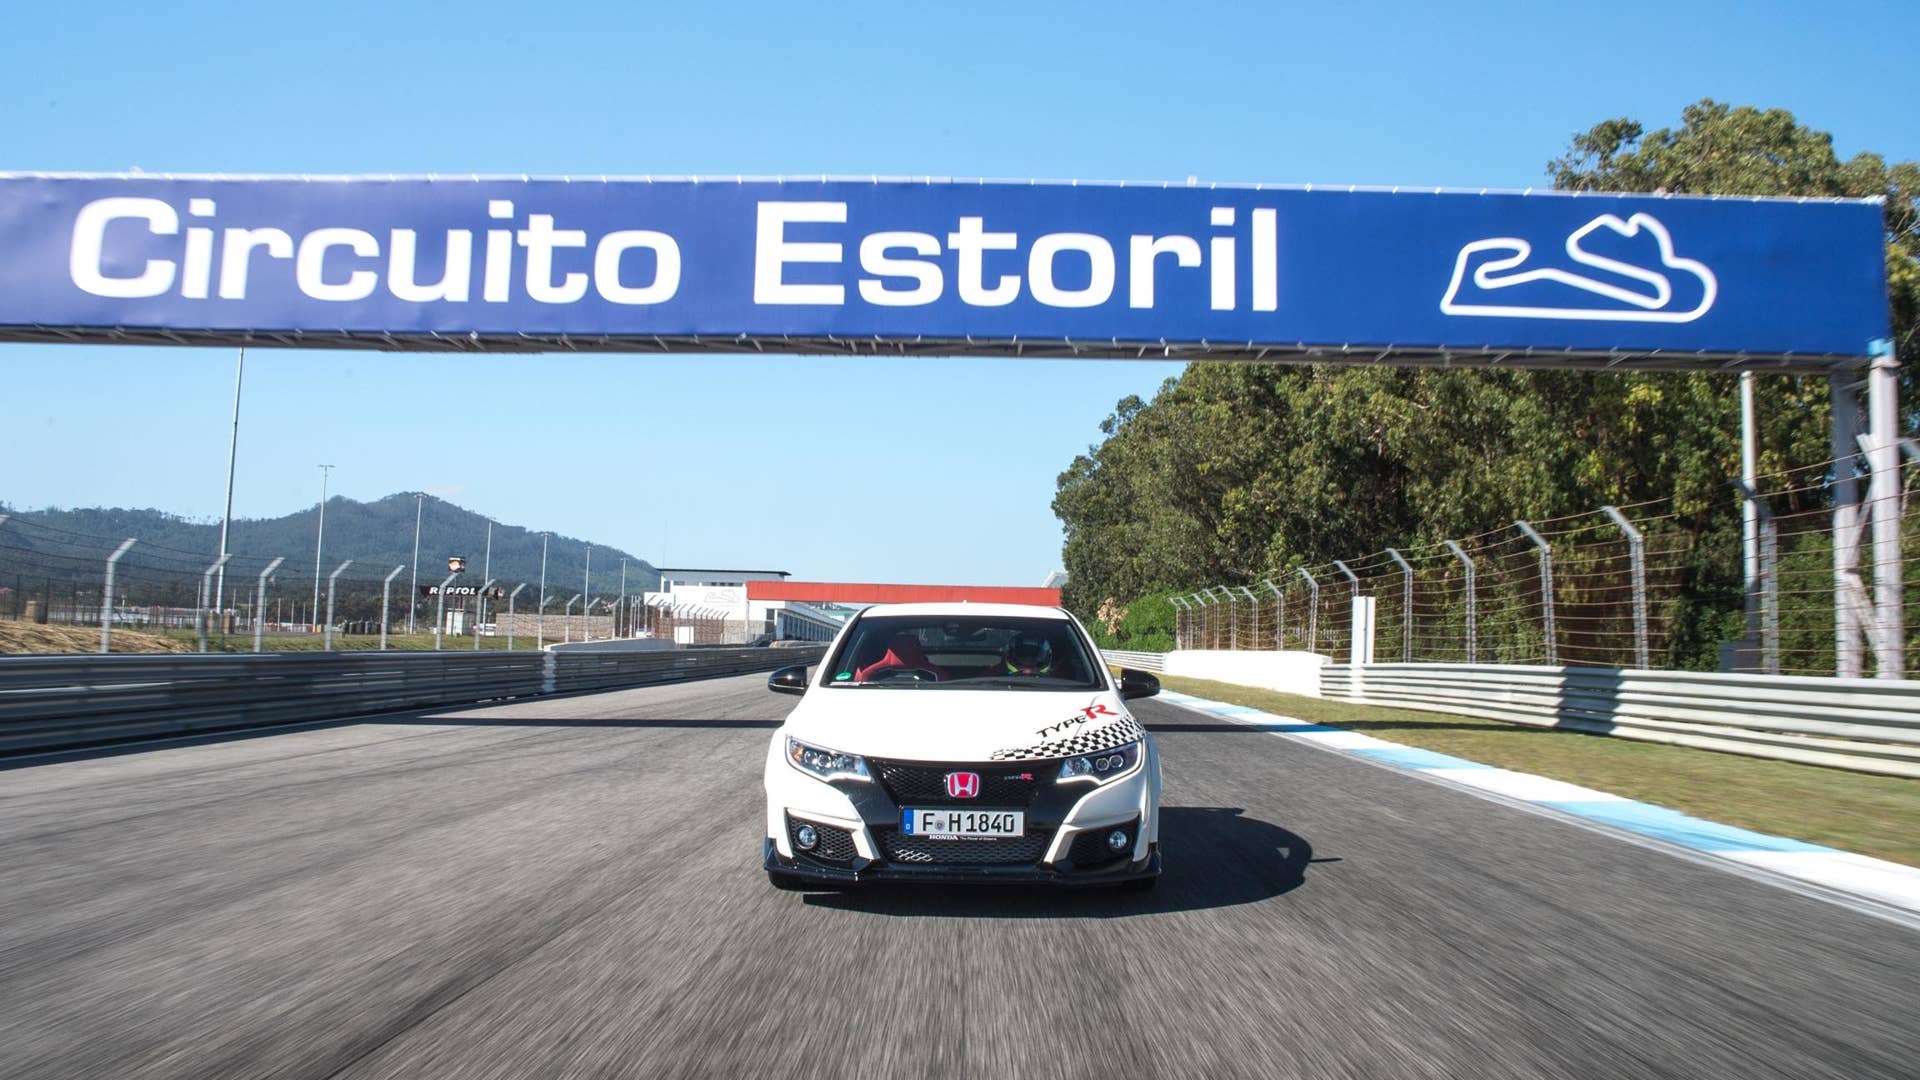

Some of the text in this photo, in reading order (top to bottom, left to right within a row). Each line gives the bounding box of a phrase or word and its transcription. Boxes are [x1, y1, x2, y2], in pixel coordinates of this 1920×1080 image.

[69, 196, 1278, 312] Circuito Estoril
[1036, 715, 1087, 738] TYPE
